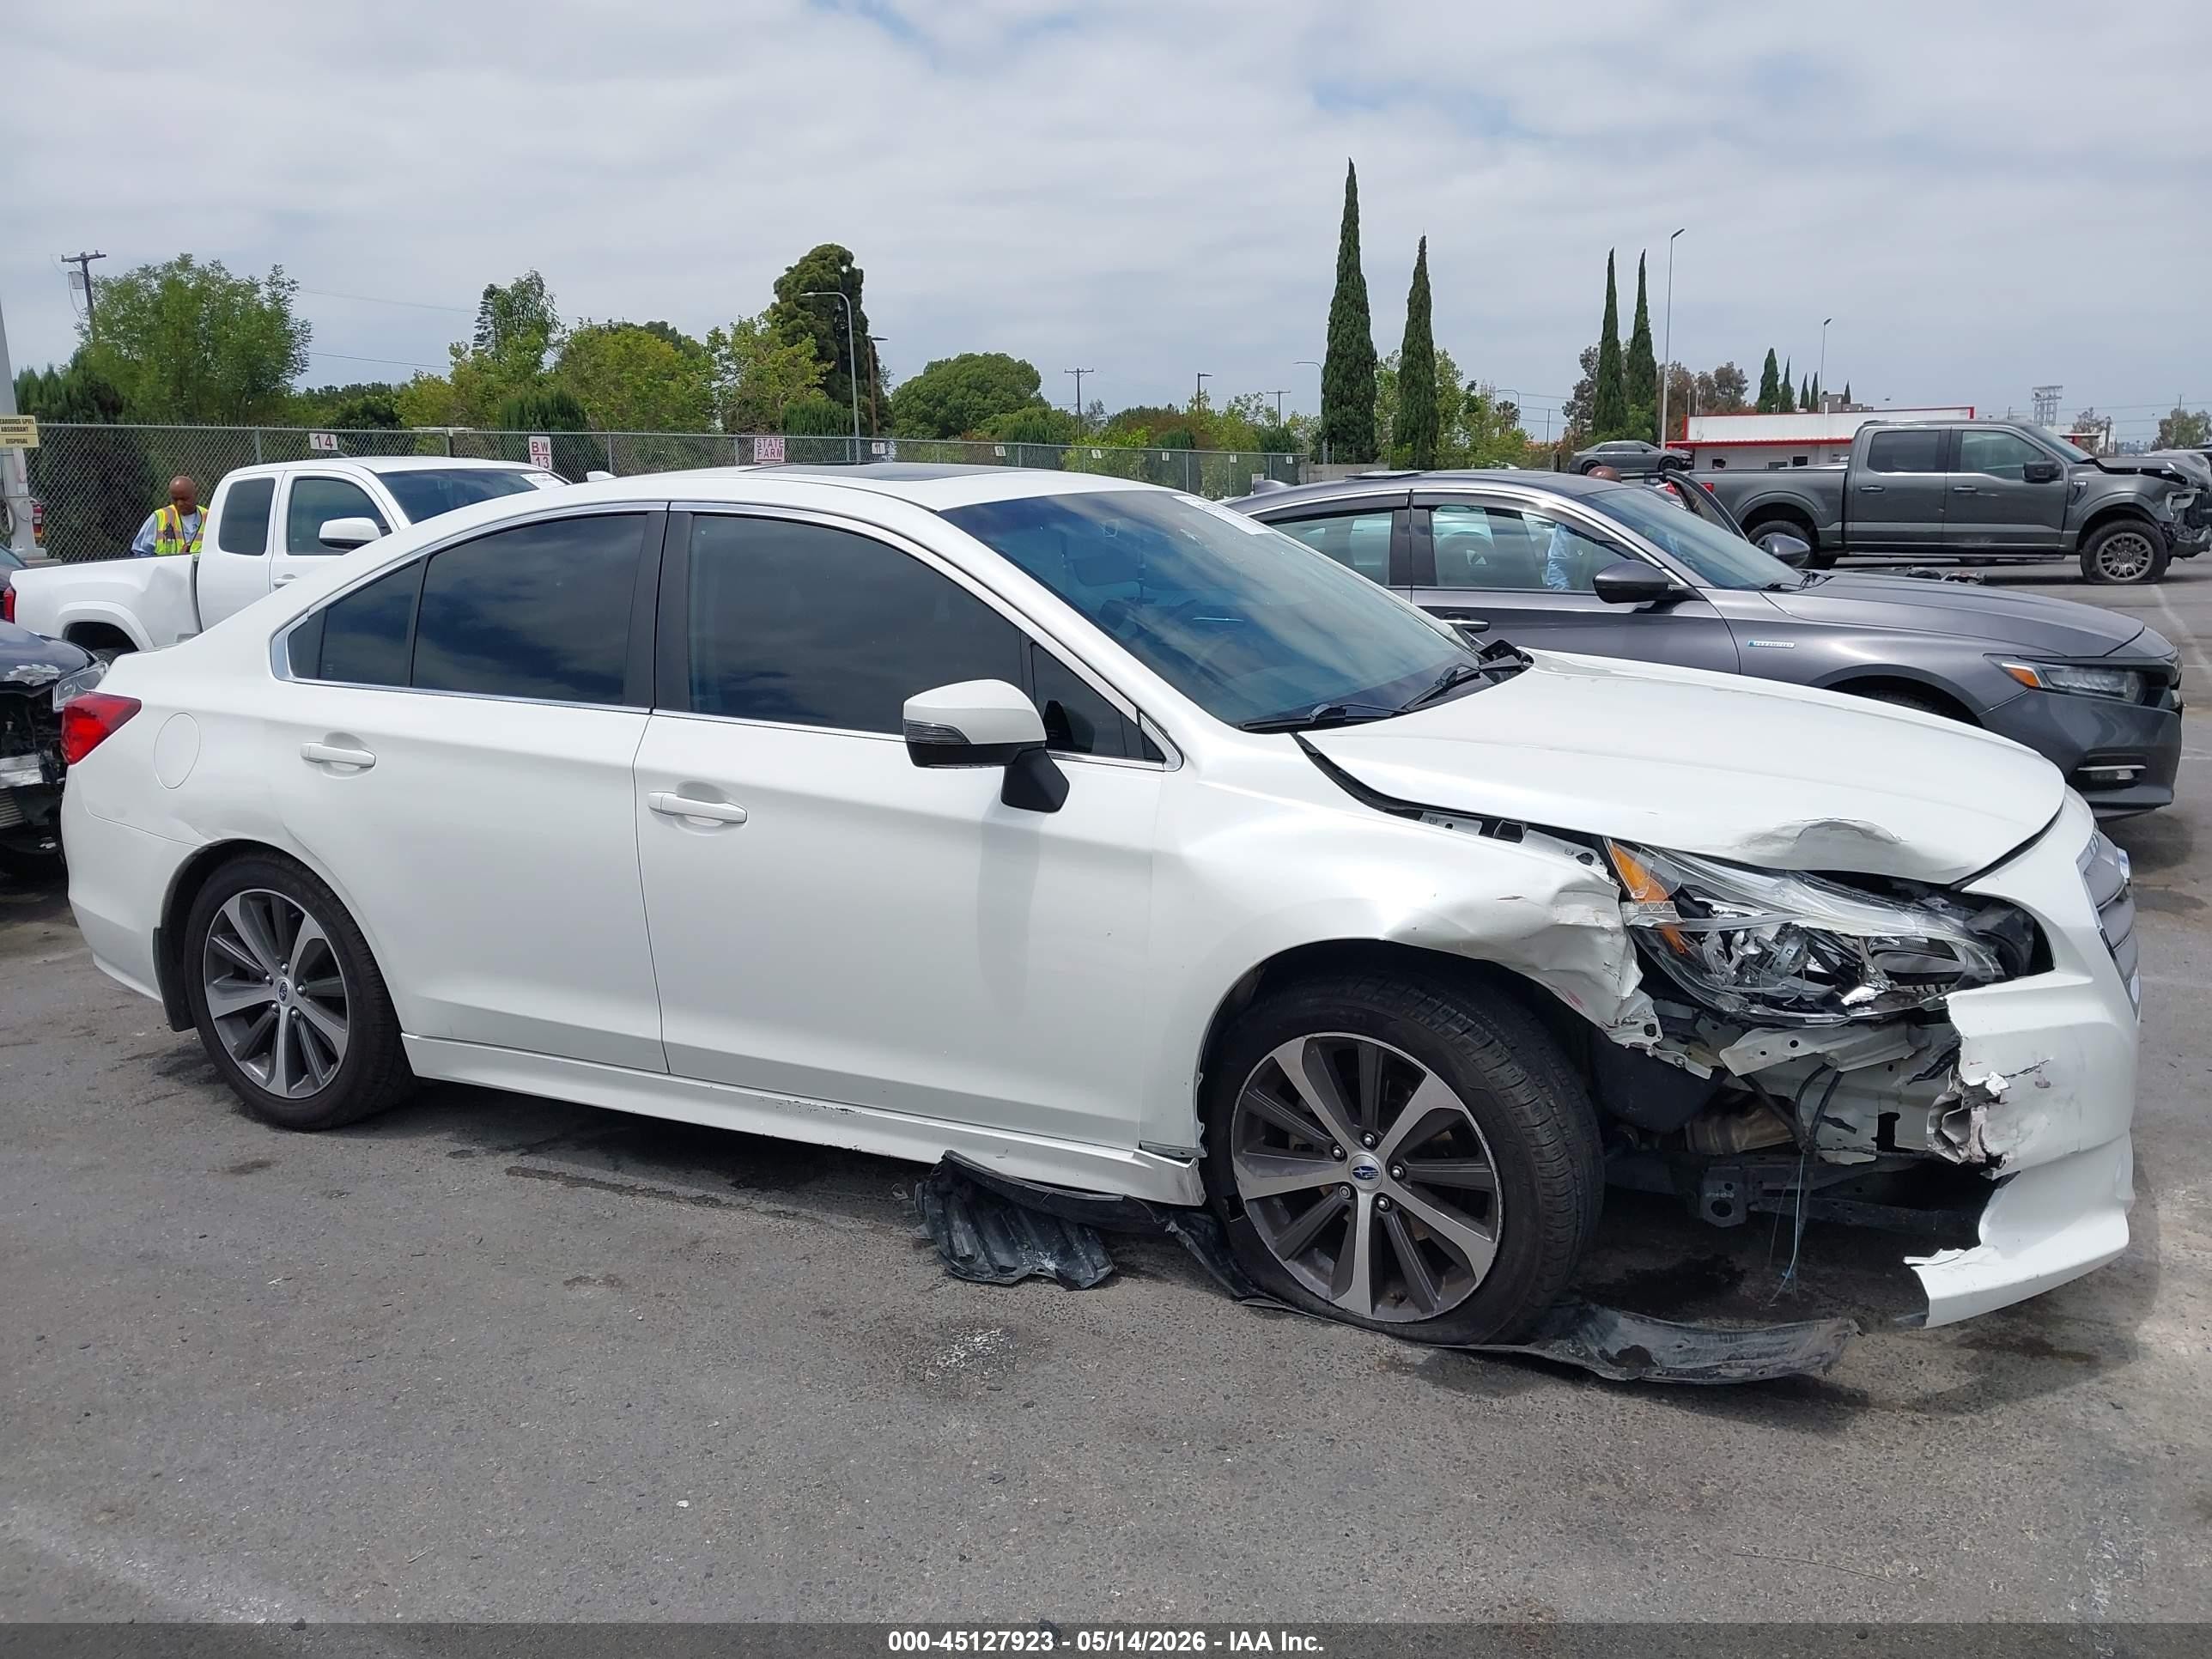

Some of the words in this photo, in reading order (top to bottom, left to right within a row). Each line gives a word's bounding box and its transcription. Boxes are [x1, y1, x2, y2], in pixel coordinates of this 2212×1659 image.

[314, 434, 334, 449] 14
[757, 439, 783, 447] STATE
[757, 448, 783, 458] FARM
[535, 456, 550, 468] 13
